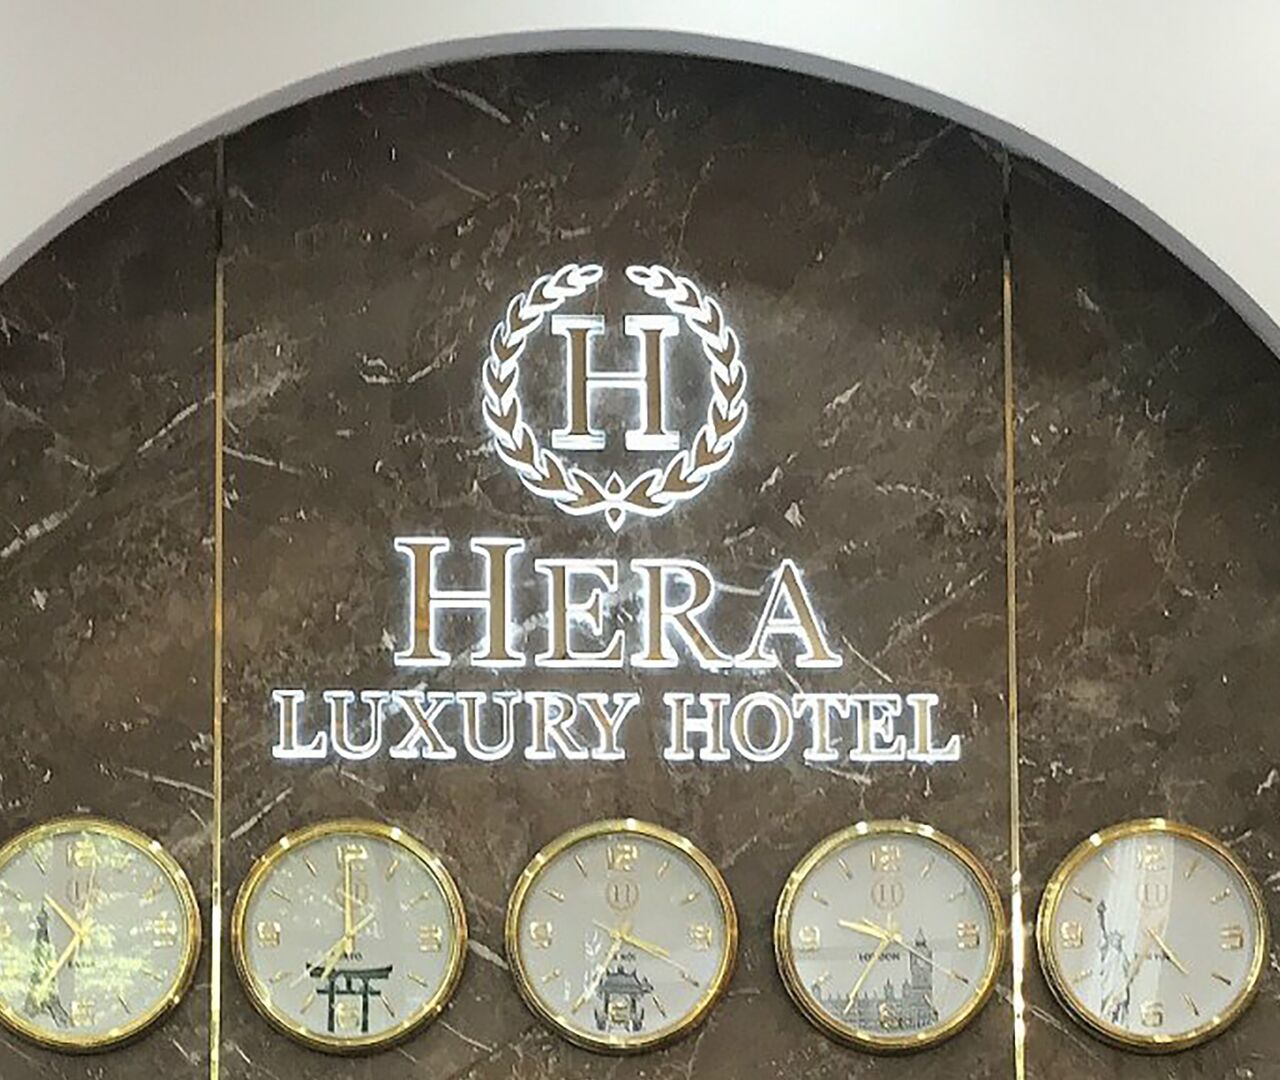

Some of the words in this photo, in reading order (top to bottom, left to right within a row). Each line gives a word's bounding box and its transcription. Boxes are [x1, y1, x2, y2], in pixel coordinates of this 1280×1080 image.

[548, 313, 681, 452] H
[394, 536, 843, 670] HERA
[272, 690, 639, 761] LUXURY
[664, 690, 962, 762] HOTEL
[607, 844, 638, 871] 12
[871, 845, 900, 871] 12
